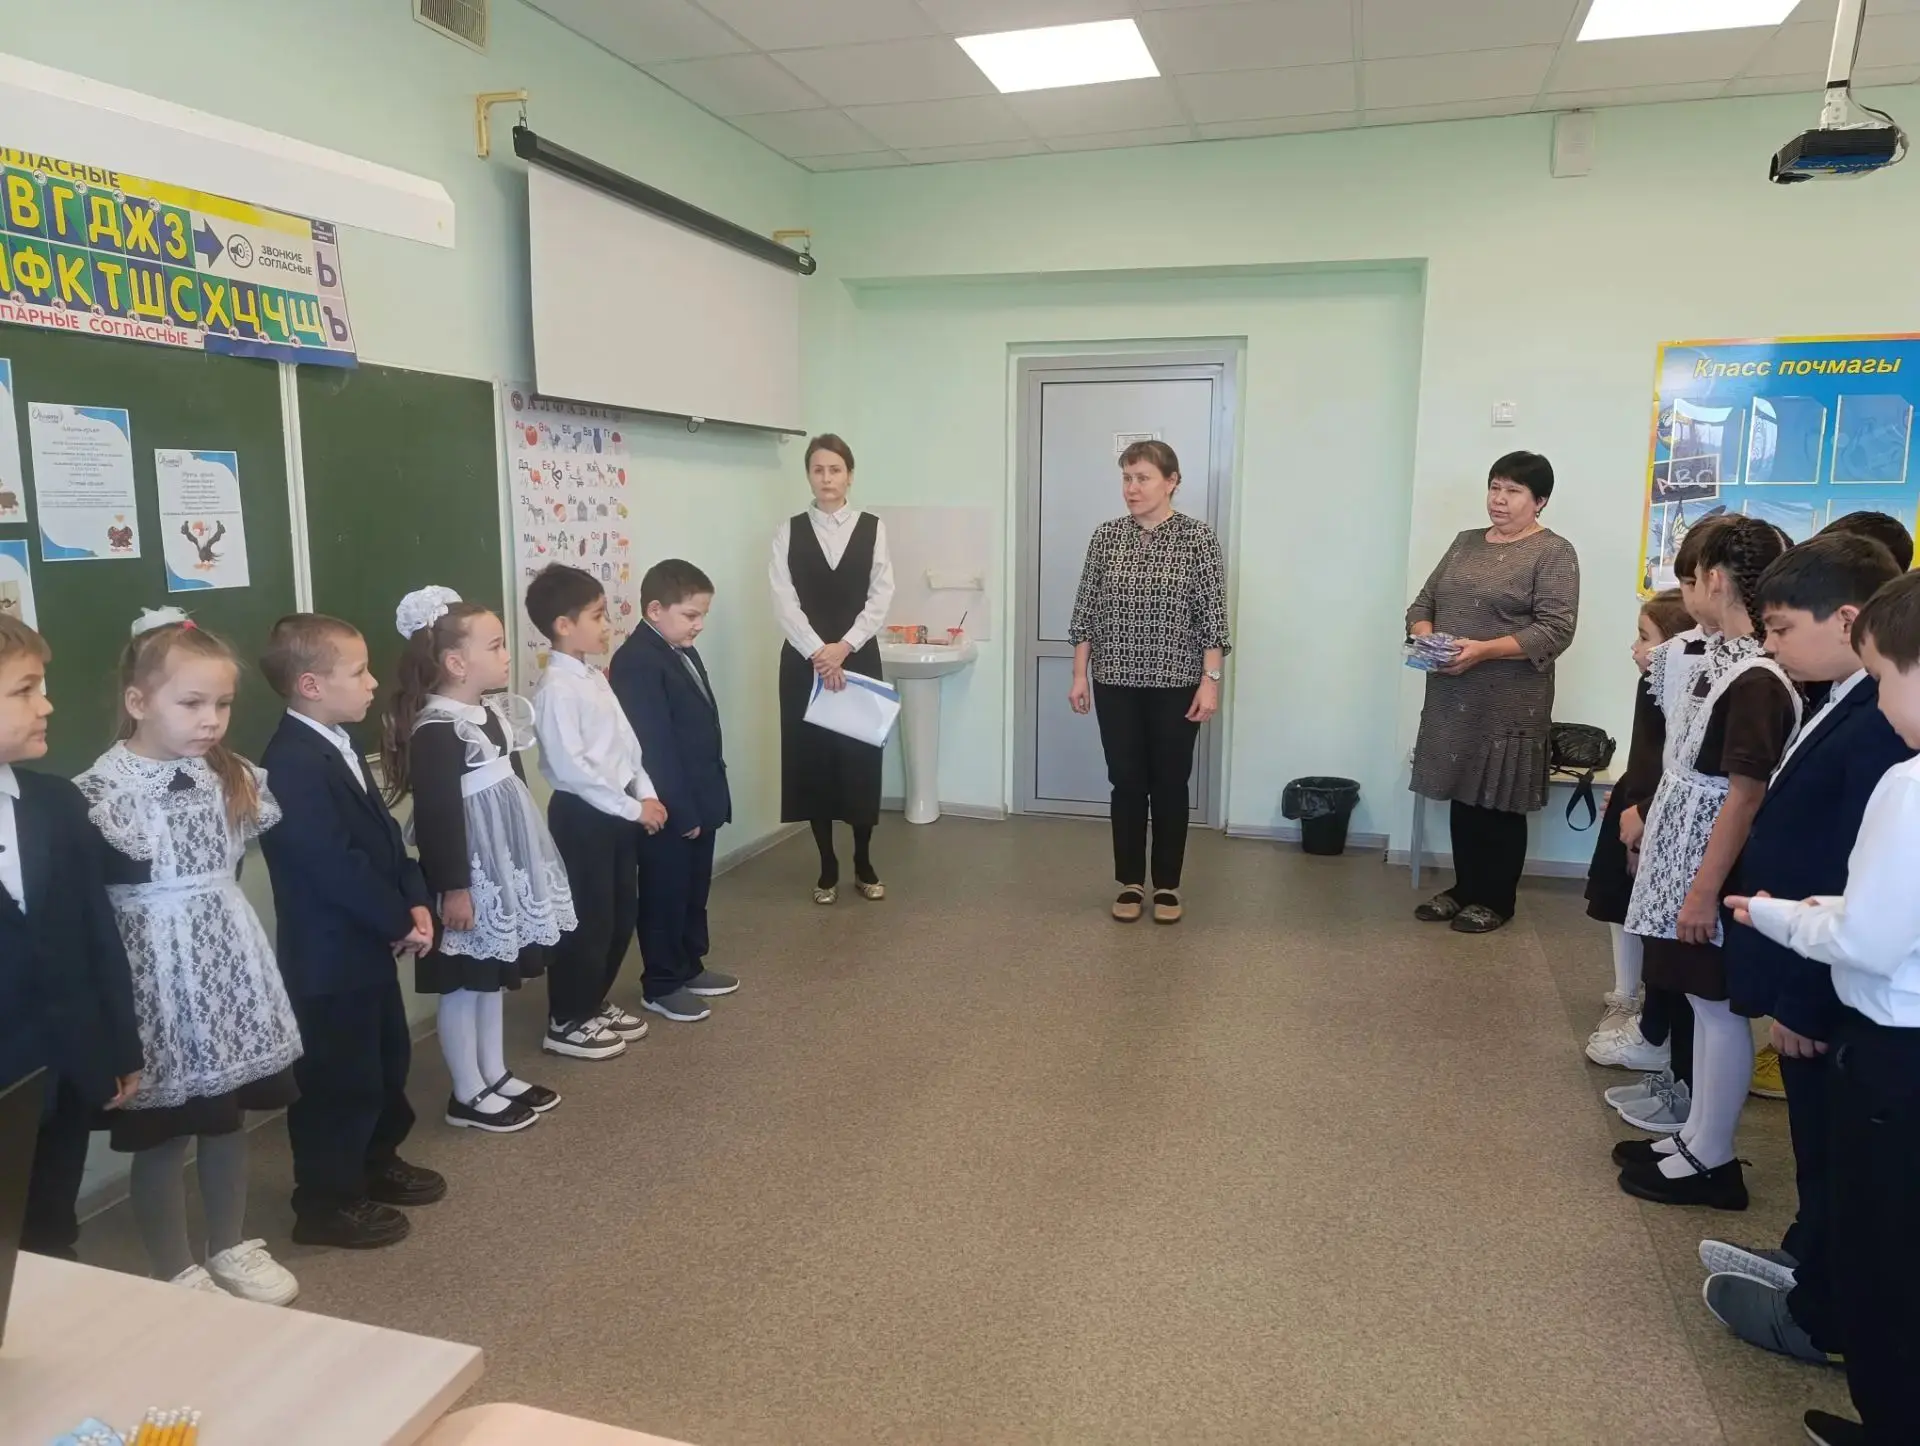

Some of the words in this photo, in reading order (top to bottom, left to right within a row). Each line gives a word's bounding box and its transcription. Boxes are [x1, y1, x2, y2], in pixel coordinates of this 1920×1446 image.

[261, 245, 303, 263] ЗВОНКИЕ
[258, 256, 313, 276] СОГЛАСНЫЕ
[0, 304, 79, 329] ПАРНЫЕ
[88, 318, 188, 345] СОГЛАСНЫЕ
[1693, 359, 1771, 379] Класс
[1778, 358, 1902, 376] почмагы
